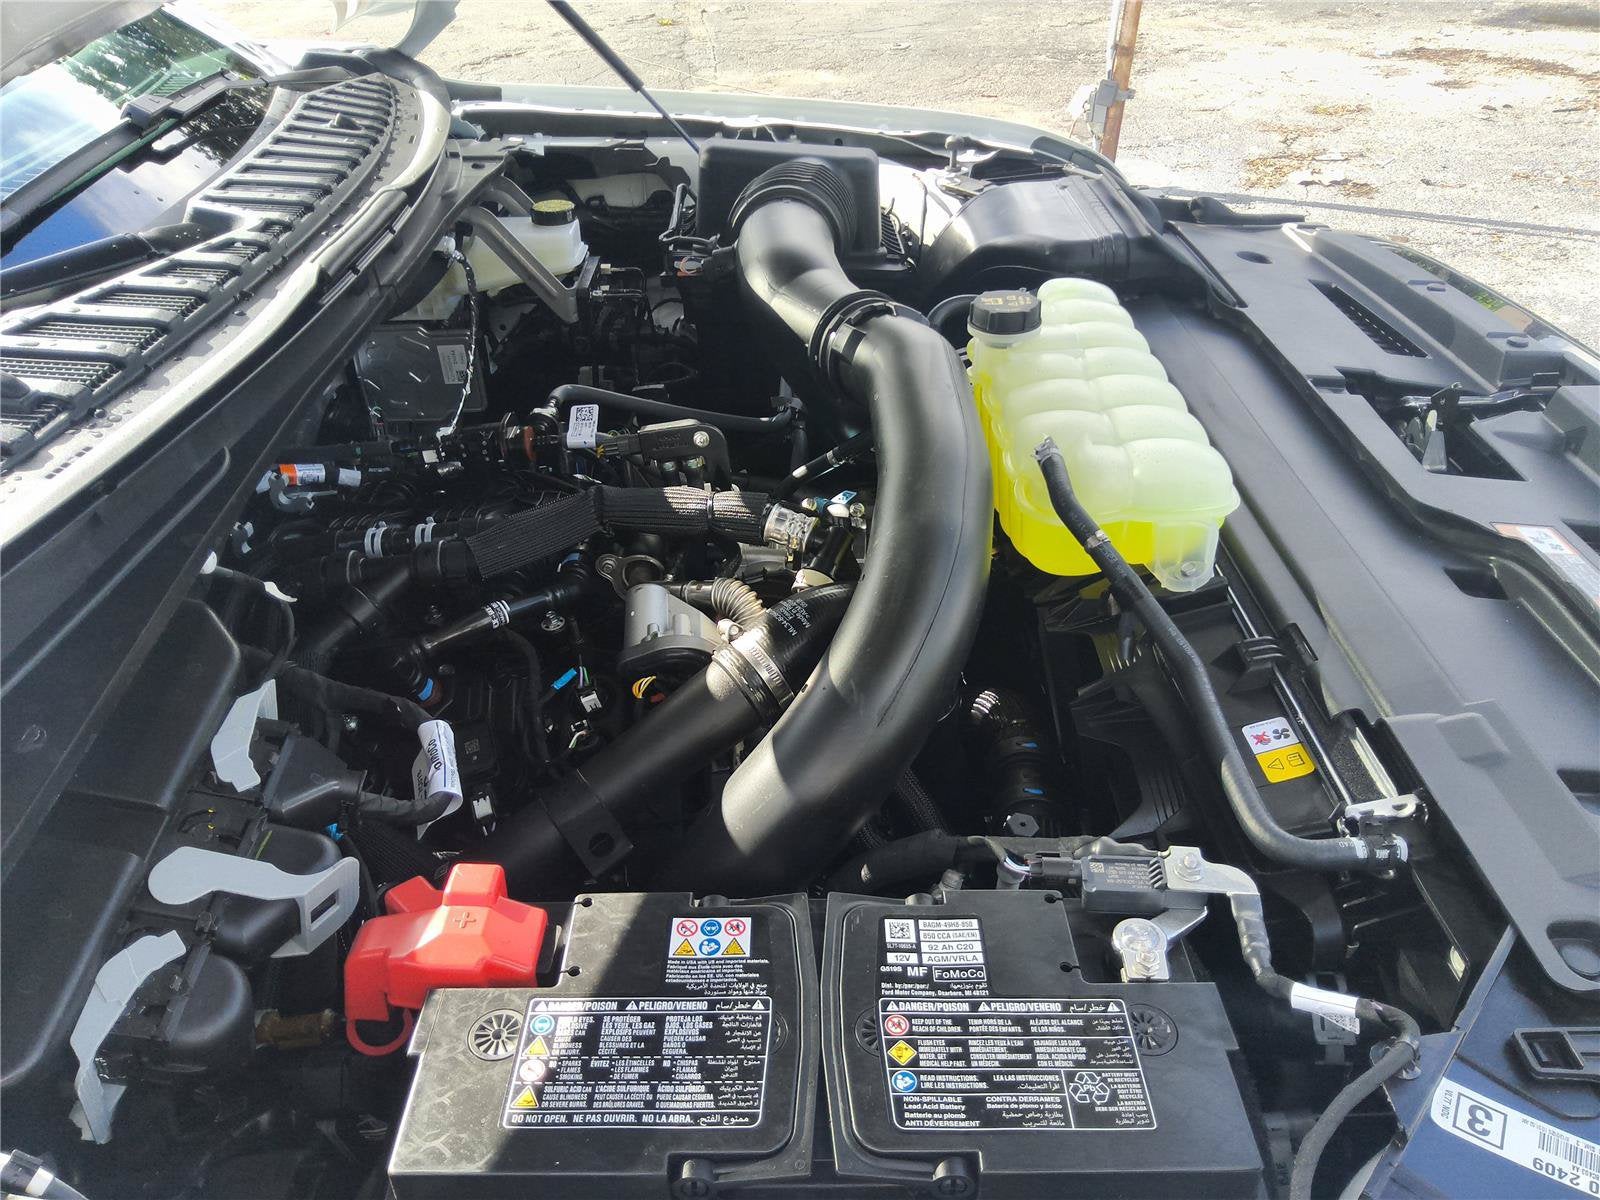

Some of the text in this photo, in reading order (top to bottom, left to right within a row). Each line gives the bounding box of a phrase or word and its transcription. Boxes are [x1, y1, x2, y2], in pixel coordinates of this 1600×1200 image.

[907, 967, 928, 976] MF
[935, 969, 984, 978] FoMoCo
[638, 1000, 708, 1010] PELIGRO/VENENO
[899, 1002, 969, 1011] DANGER/POISON
[990, 1002, 1061, 1012] PELIGRO/VENENO
[612, 1014, 641, 1022] PROTÉGER
[590, 1059, 609, 1067] ÉVITEZ
[603, 1114, 637, 1122] OUVRIR.
[642, 1114, 654, 1122] NO
[656, 1114, 668, 1122] LA
[668, 1114, 693, 1122] ABRA.
[1467, 1104, 1493, 1136] 3
[924, 1119, 980, 1127] DÉVERSEMENT
[1532, 1157, 1580, 1187] 2409
